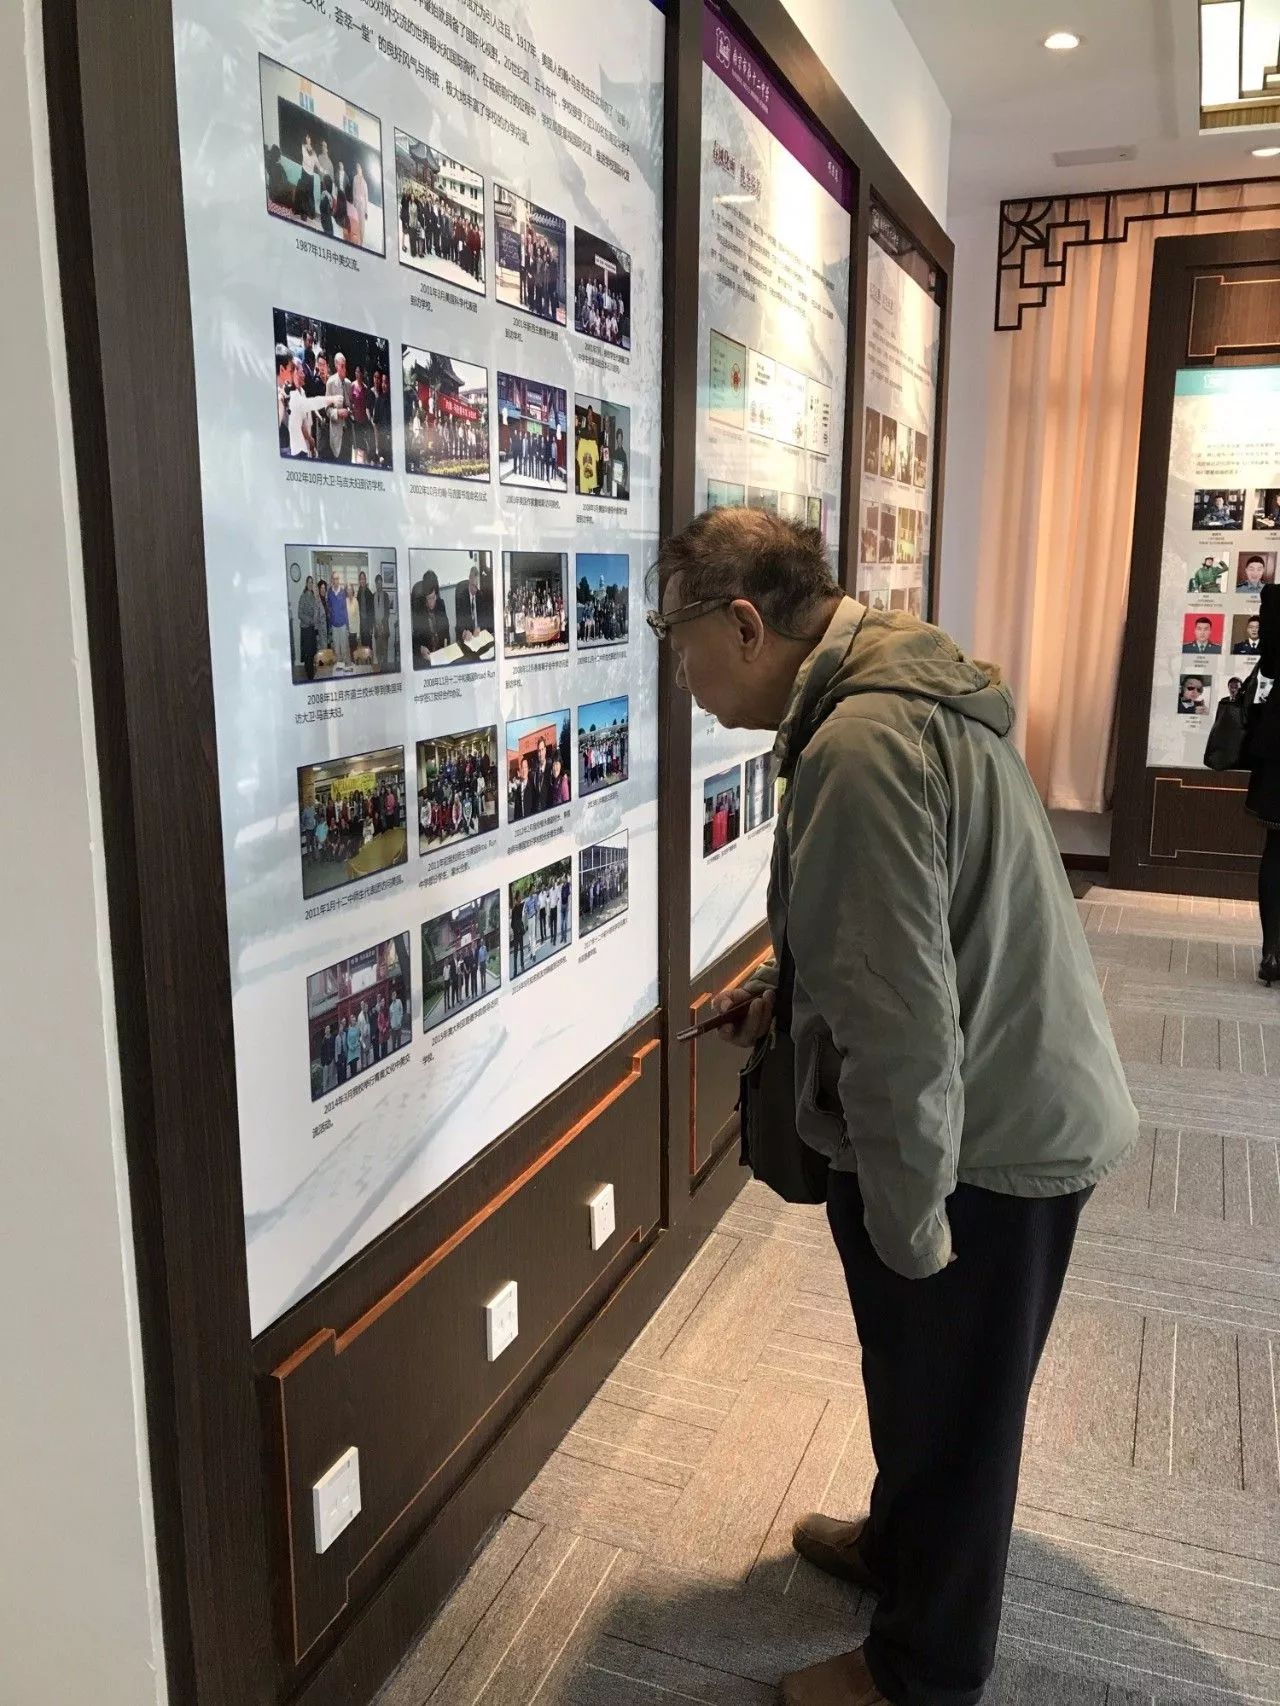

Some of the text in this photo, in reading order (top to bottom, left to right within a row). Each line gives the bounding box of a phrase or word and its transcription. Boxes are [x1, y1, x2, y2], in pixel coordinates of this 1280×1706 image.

[295, 236, 360, 273] 1987年11月中美交流。
